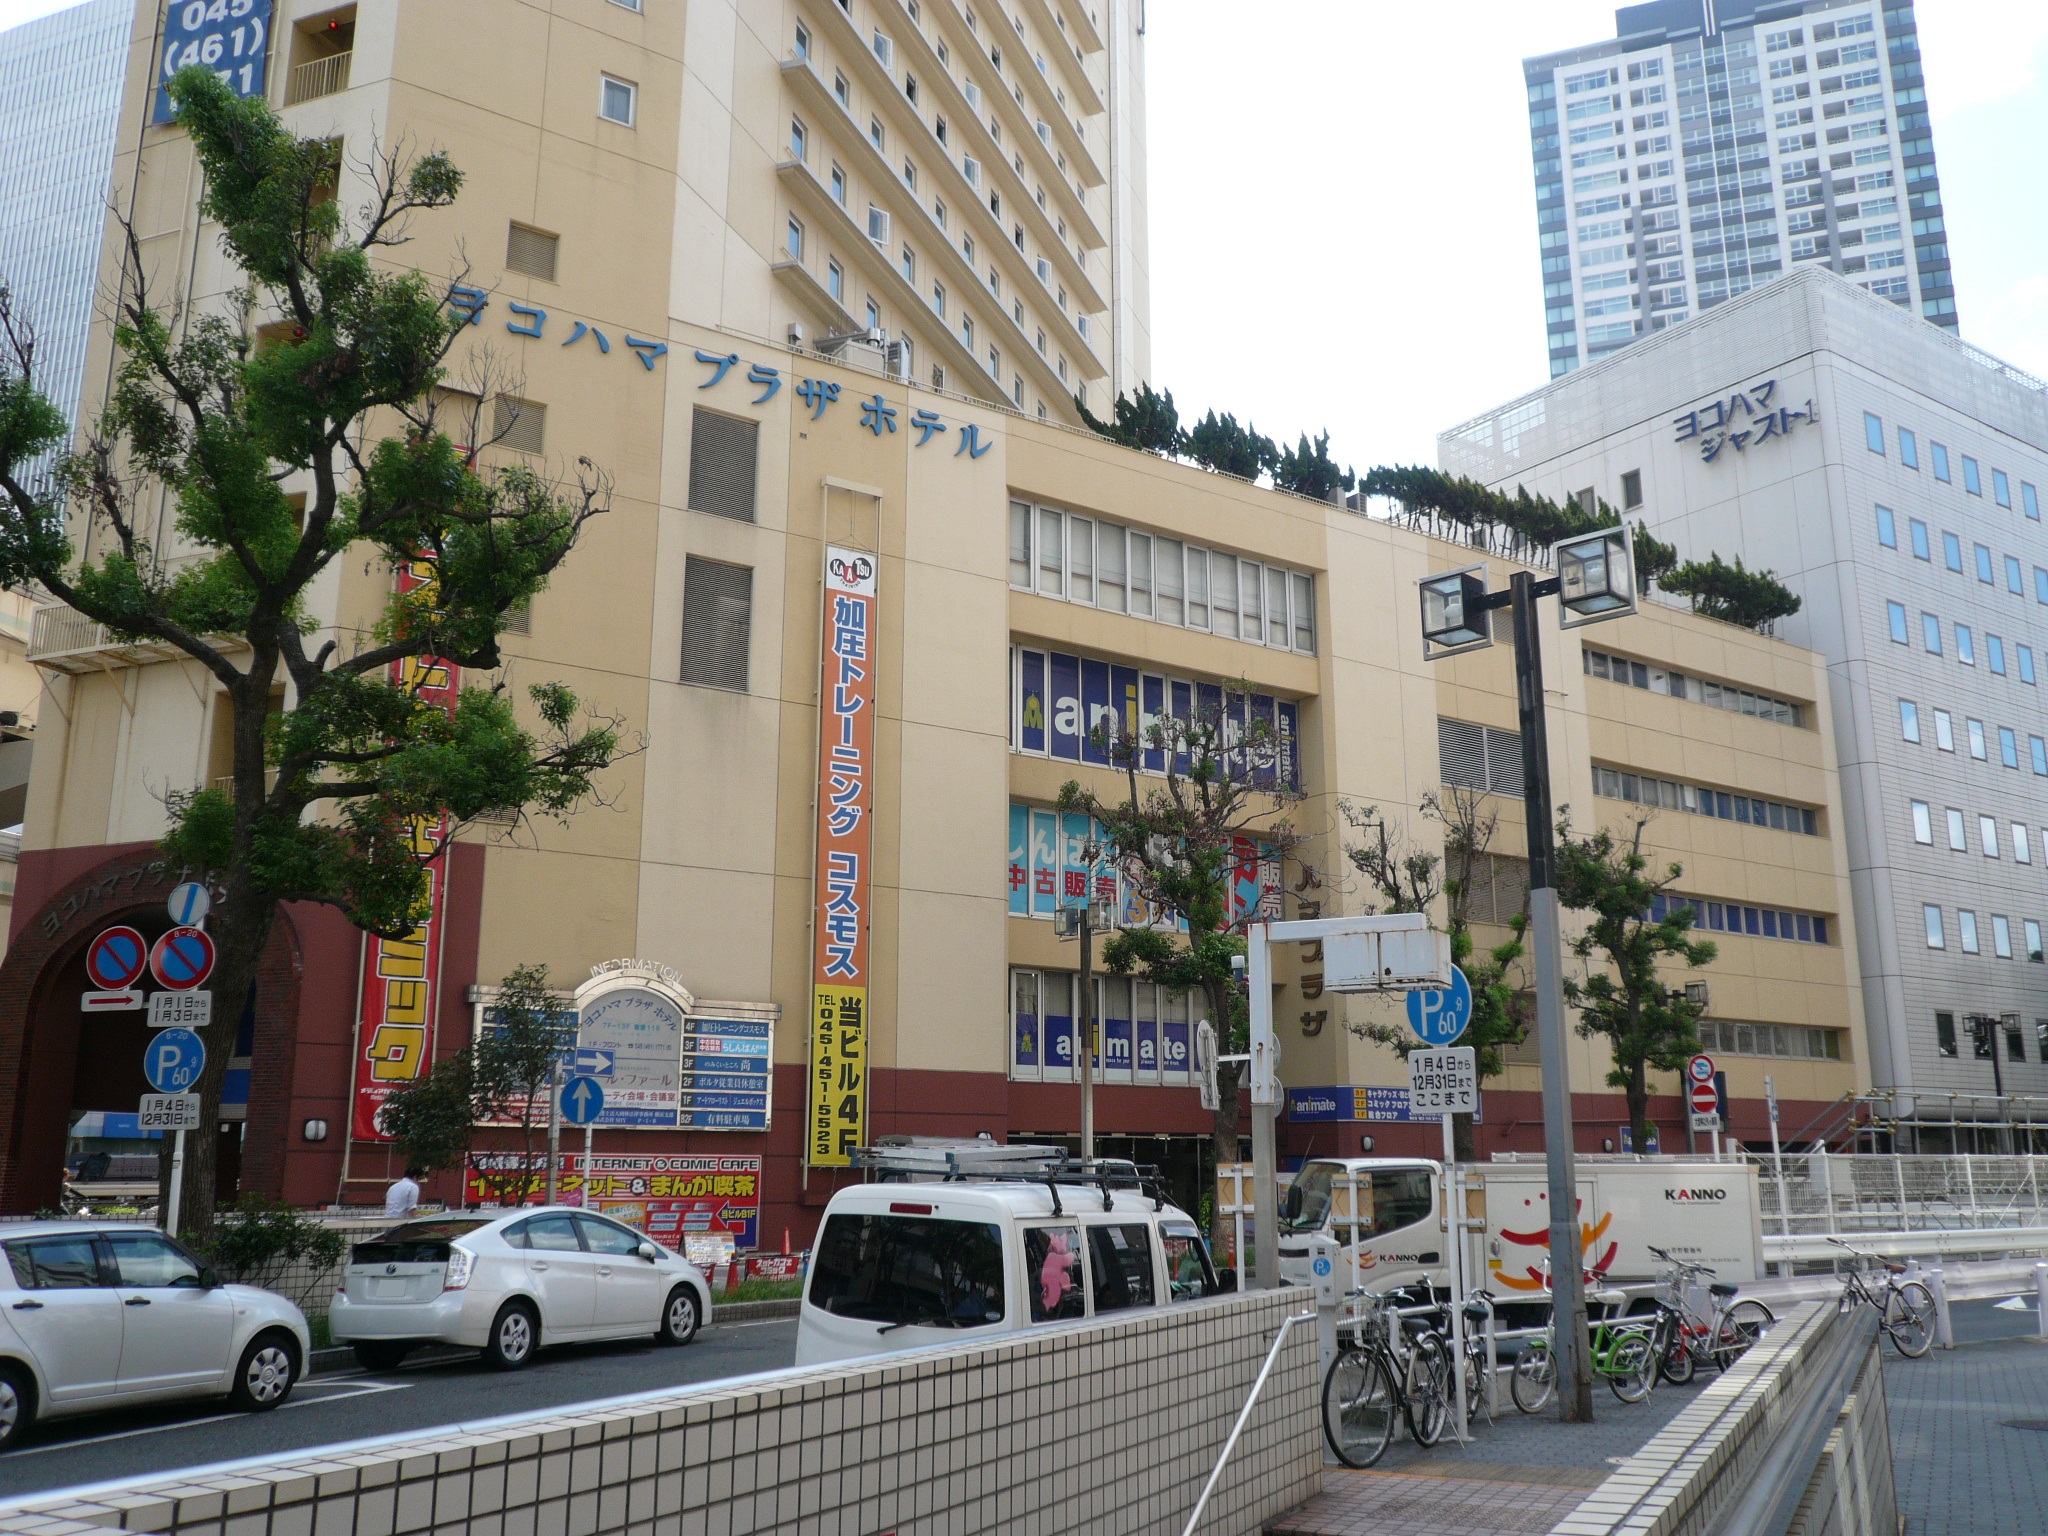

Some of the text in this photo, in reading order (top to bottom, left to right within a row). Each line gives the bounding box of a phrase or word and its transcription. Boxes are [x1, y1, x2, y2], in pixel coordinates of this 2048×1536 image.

[164, 17, 264, 77] (461)
[1673, 380, 1778, 443] ヨコハマ
[839, 578, 862, 588] TRAINING
[1280, 714, 1295, 782] animate
[823, 594, 867, 979] 加圧トレーニング コスモス
[173, 929, 198, 939] 8-20
[590, 958, 683, 984] INFORMATION
[156, 997, 207, 1009] 1月1日から
[818, 994, 836, 1006] TEL
[154, 1010, 207, 1023] 1月3日まで
[1420, 990, 1463, 1037] P 60 分
[685, 1022, 766, 1035] 4F 加圧トレーニングコスモス
[684, 1041, 694, 1050] 3F
[722, 1042, 757, 1053] らしんばん
[1056, 1024, 1187, 1060] aimate
[157, 1046, 181, 1085] P
[172, 1067, 189, 1085] 60
[684, 1058, 694, 1068] 3F
[1415, 1056, 1471, 1073] 1月4日から
[683, 1078, 693, 1087] 2F
[838, 996, 863, 1156] 当ビル4F
[1412, 1073, 1472, 1091] 12月31日まで
[604, 1091, 677, 1102] ーティ会場・会議室
[683, 1095, 692, 1104] 1F
[1355, 1089, 1365, 1097] 3F
[1416, 1091, 1470, 1107] ここまで
[146, 1100, 196, 1112] 1月4日から
[1297, 1096, 1336, 1111] animate
[1355, 1099, 1365, 1107] 2F
[141, 1112, 196, 1126] 12月31日まで
[681, 1113, 751, 1126] B2F 有料駐車場
[669, 1158, 718, 1171] COMIC
[720, 1159, 759, 1171] CAFE
[630, 1177, 648, 1196] &
[651, 1175, 756, 1197] まんが喫茶
[1665, 1189, 1727, 1200] KANNO
[721, 1209, 757, 1220] 当ビルB1F
[1380, 1254, 1418, 1262] KANNO
